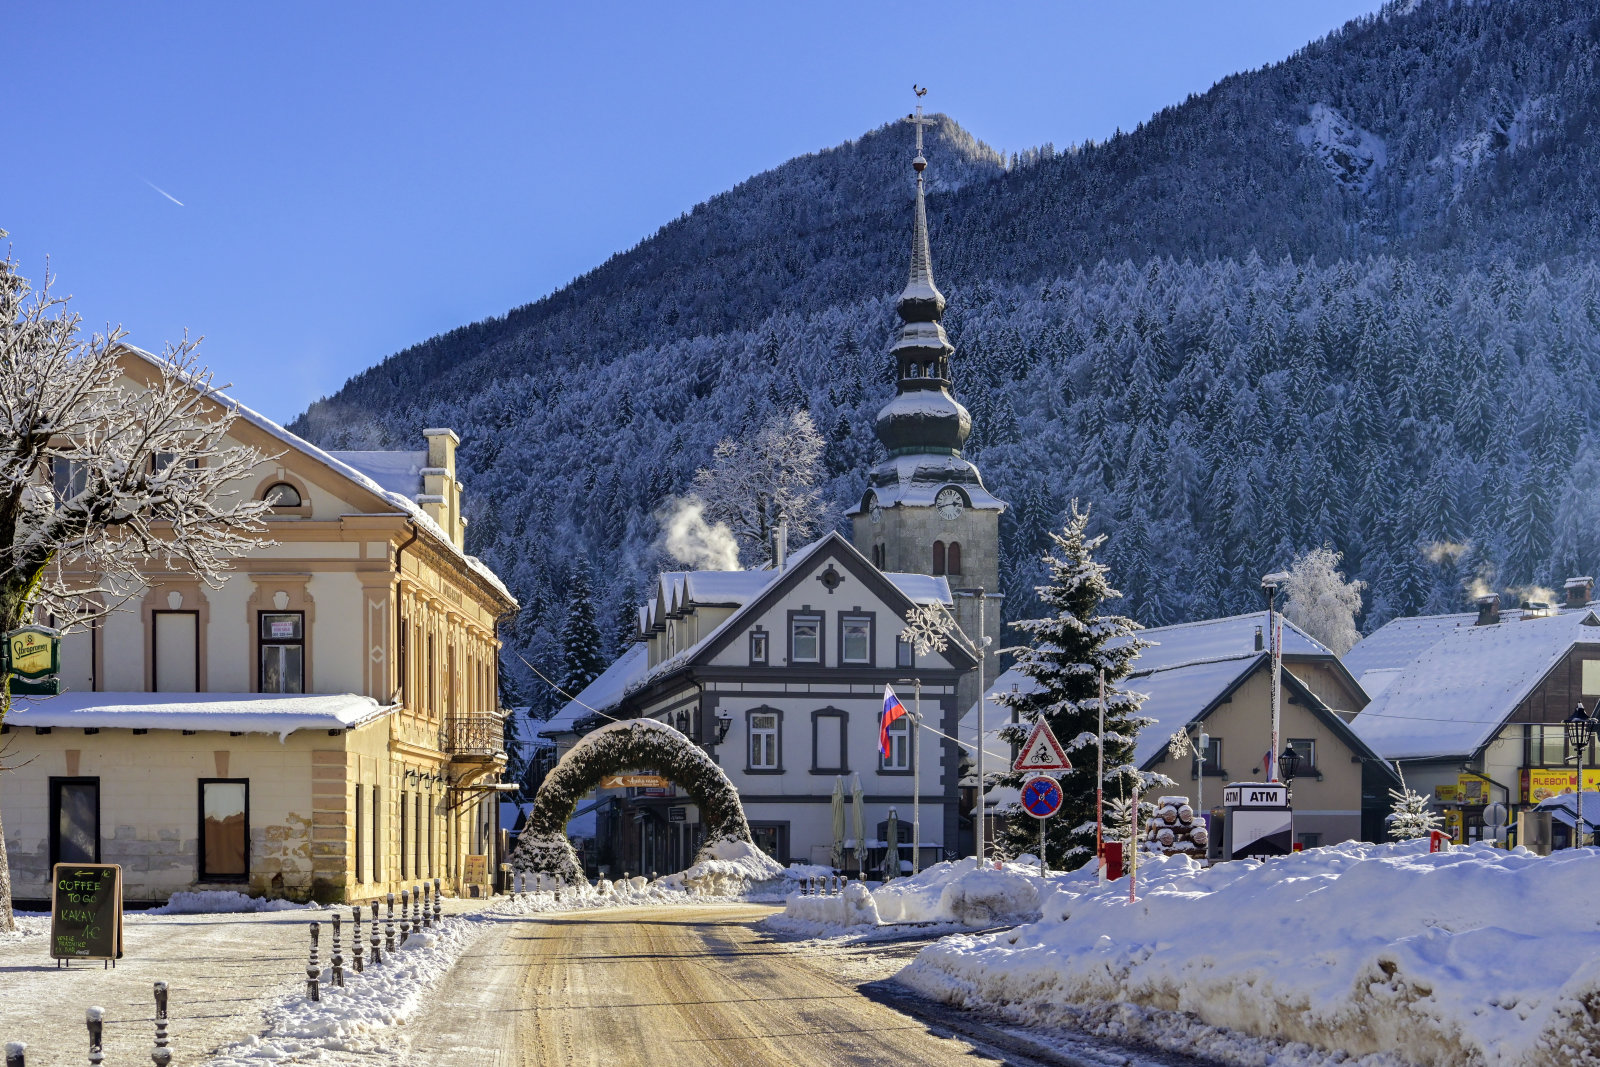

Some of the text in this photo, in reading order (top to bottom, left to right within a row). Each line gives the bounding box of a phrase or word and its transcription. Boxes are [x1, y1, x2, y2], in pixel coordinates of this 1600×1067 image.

[1533, 777, 1567, 785] ALEBON
[1225, 791, 1238, 802] ATM
[1250, 792, 1278, 802] ATM
[58, 880, 101, 891] COFFEE
[68, 893, 97, 903] TO GO
[61, 909, 96, 923] KAKAV
